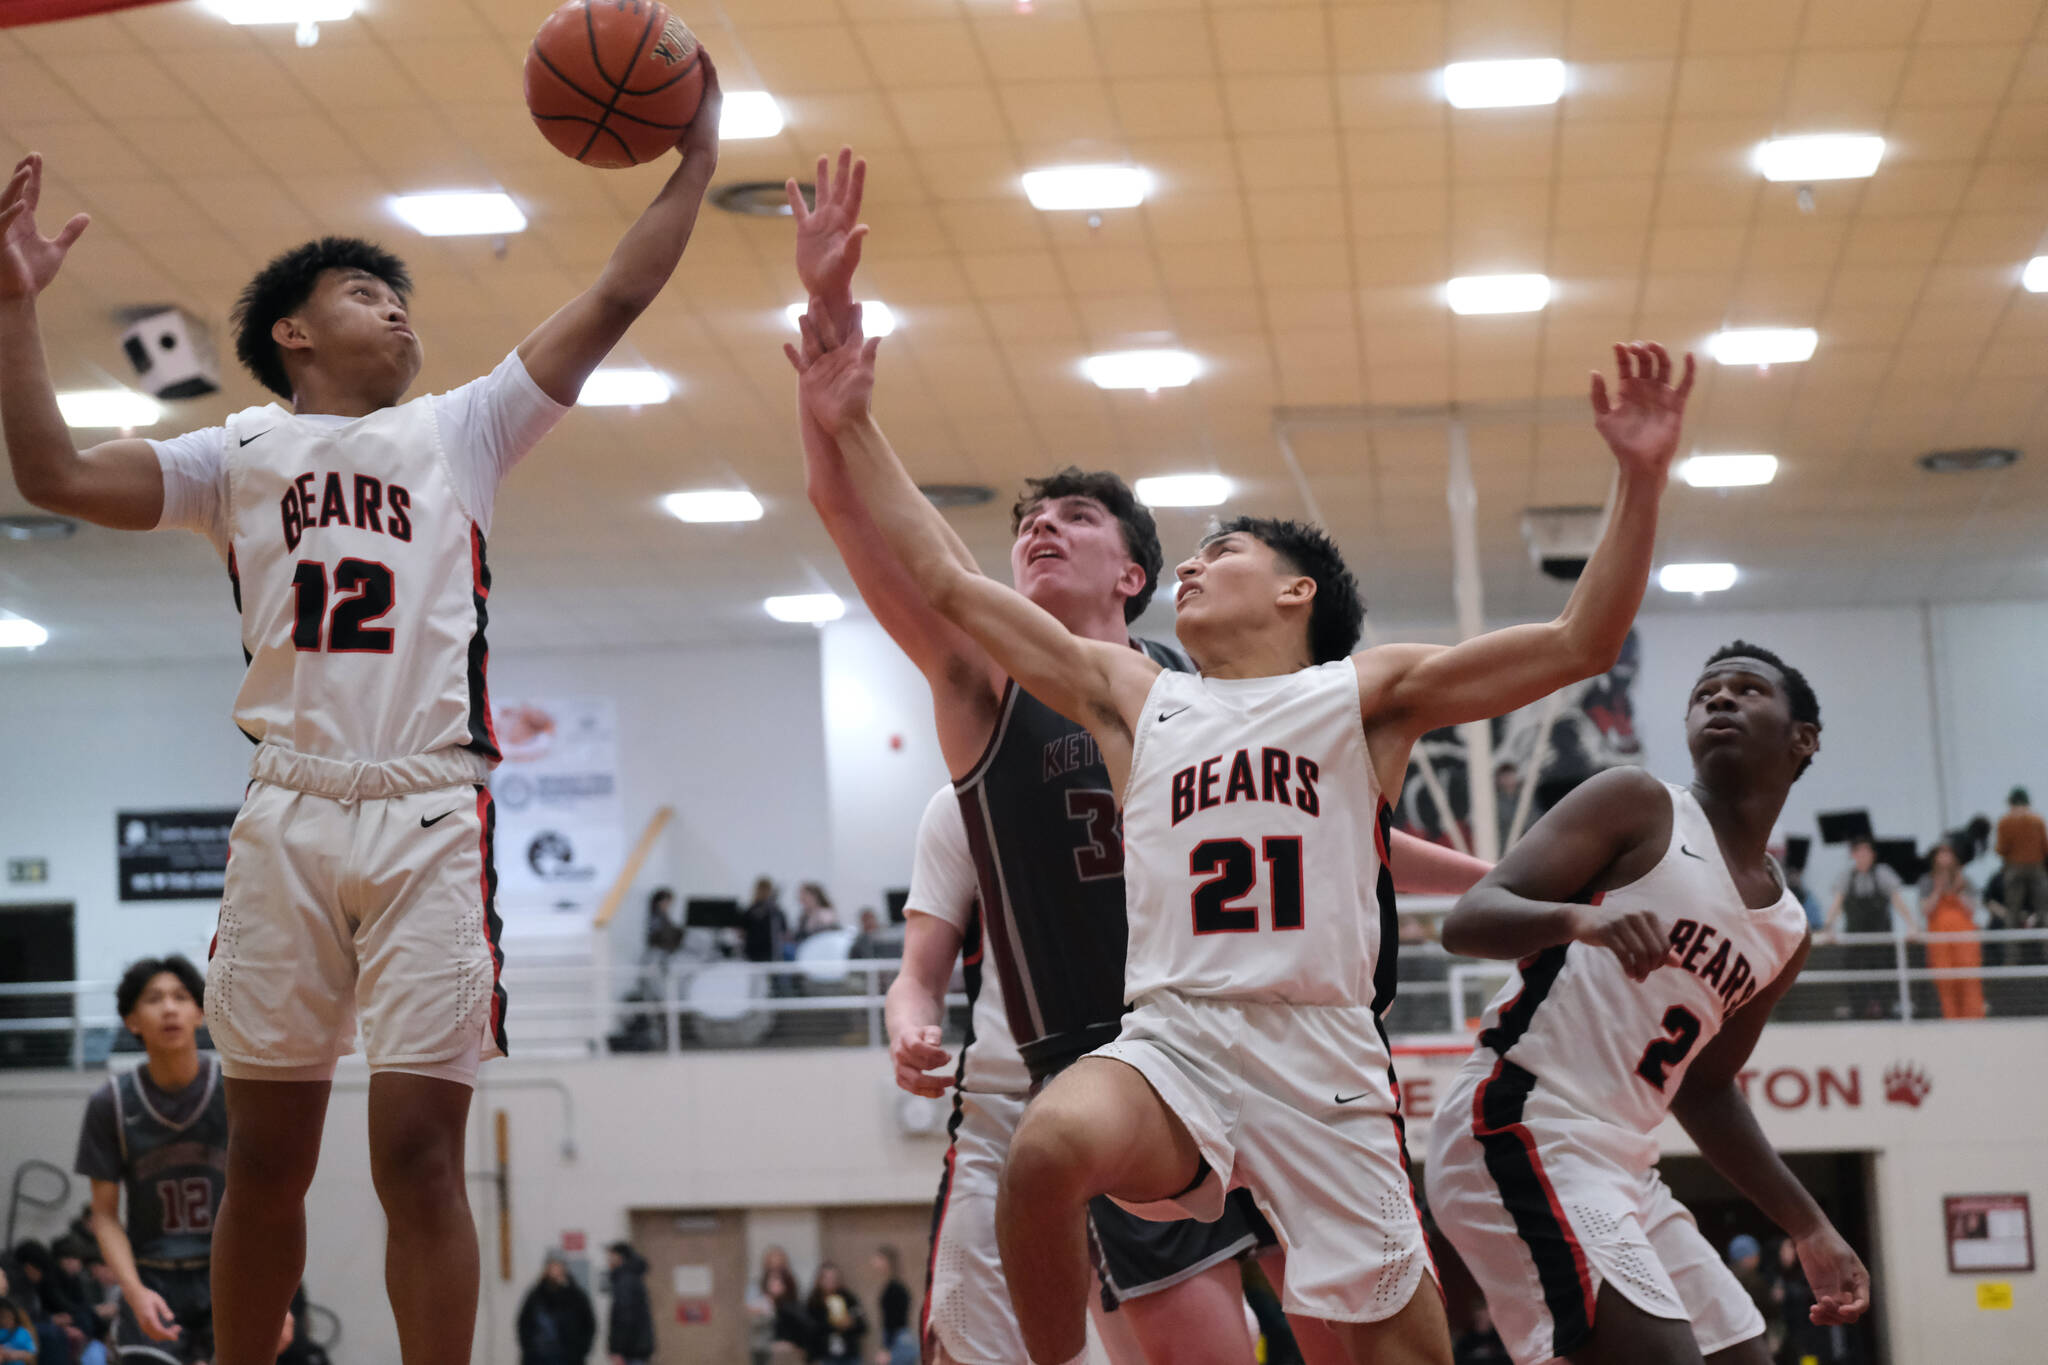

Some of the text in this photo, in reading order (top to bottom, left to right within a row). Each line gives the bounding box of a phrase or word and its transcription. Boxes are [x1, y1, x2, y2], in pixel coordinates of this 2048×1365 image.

[281, 472, 412, 555] BEARS
[291, 557, 395, 654] 12
[1043, 731, 1104, 783] KET
[1171, 747, 1320, 828] BEARS
[1189, 835, 1305, 936] 21
[1634, 1004, 1701, 1094] 2
[1735, 1064, 1861, 1110] TON
[157, 1177, 213, 1234] 12
